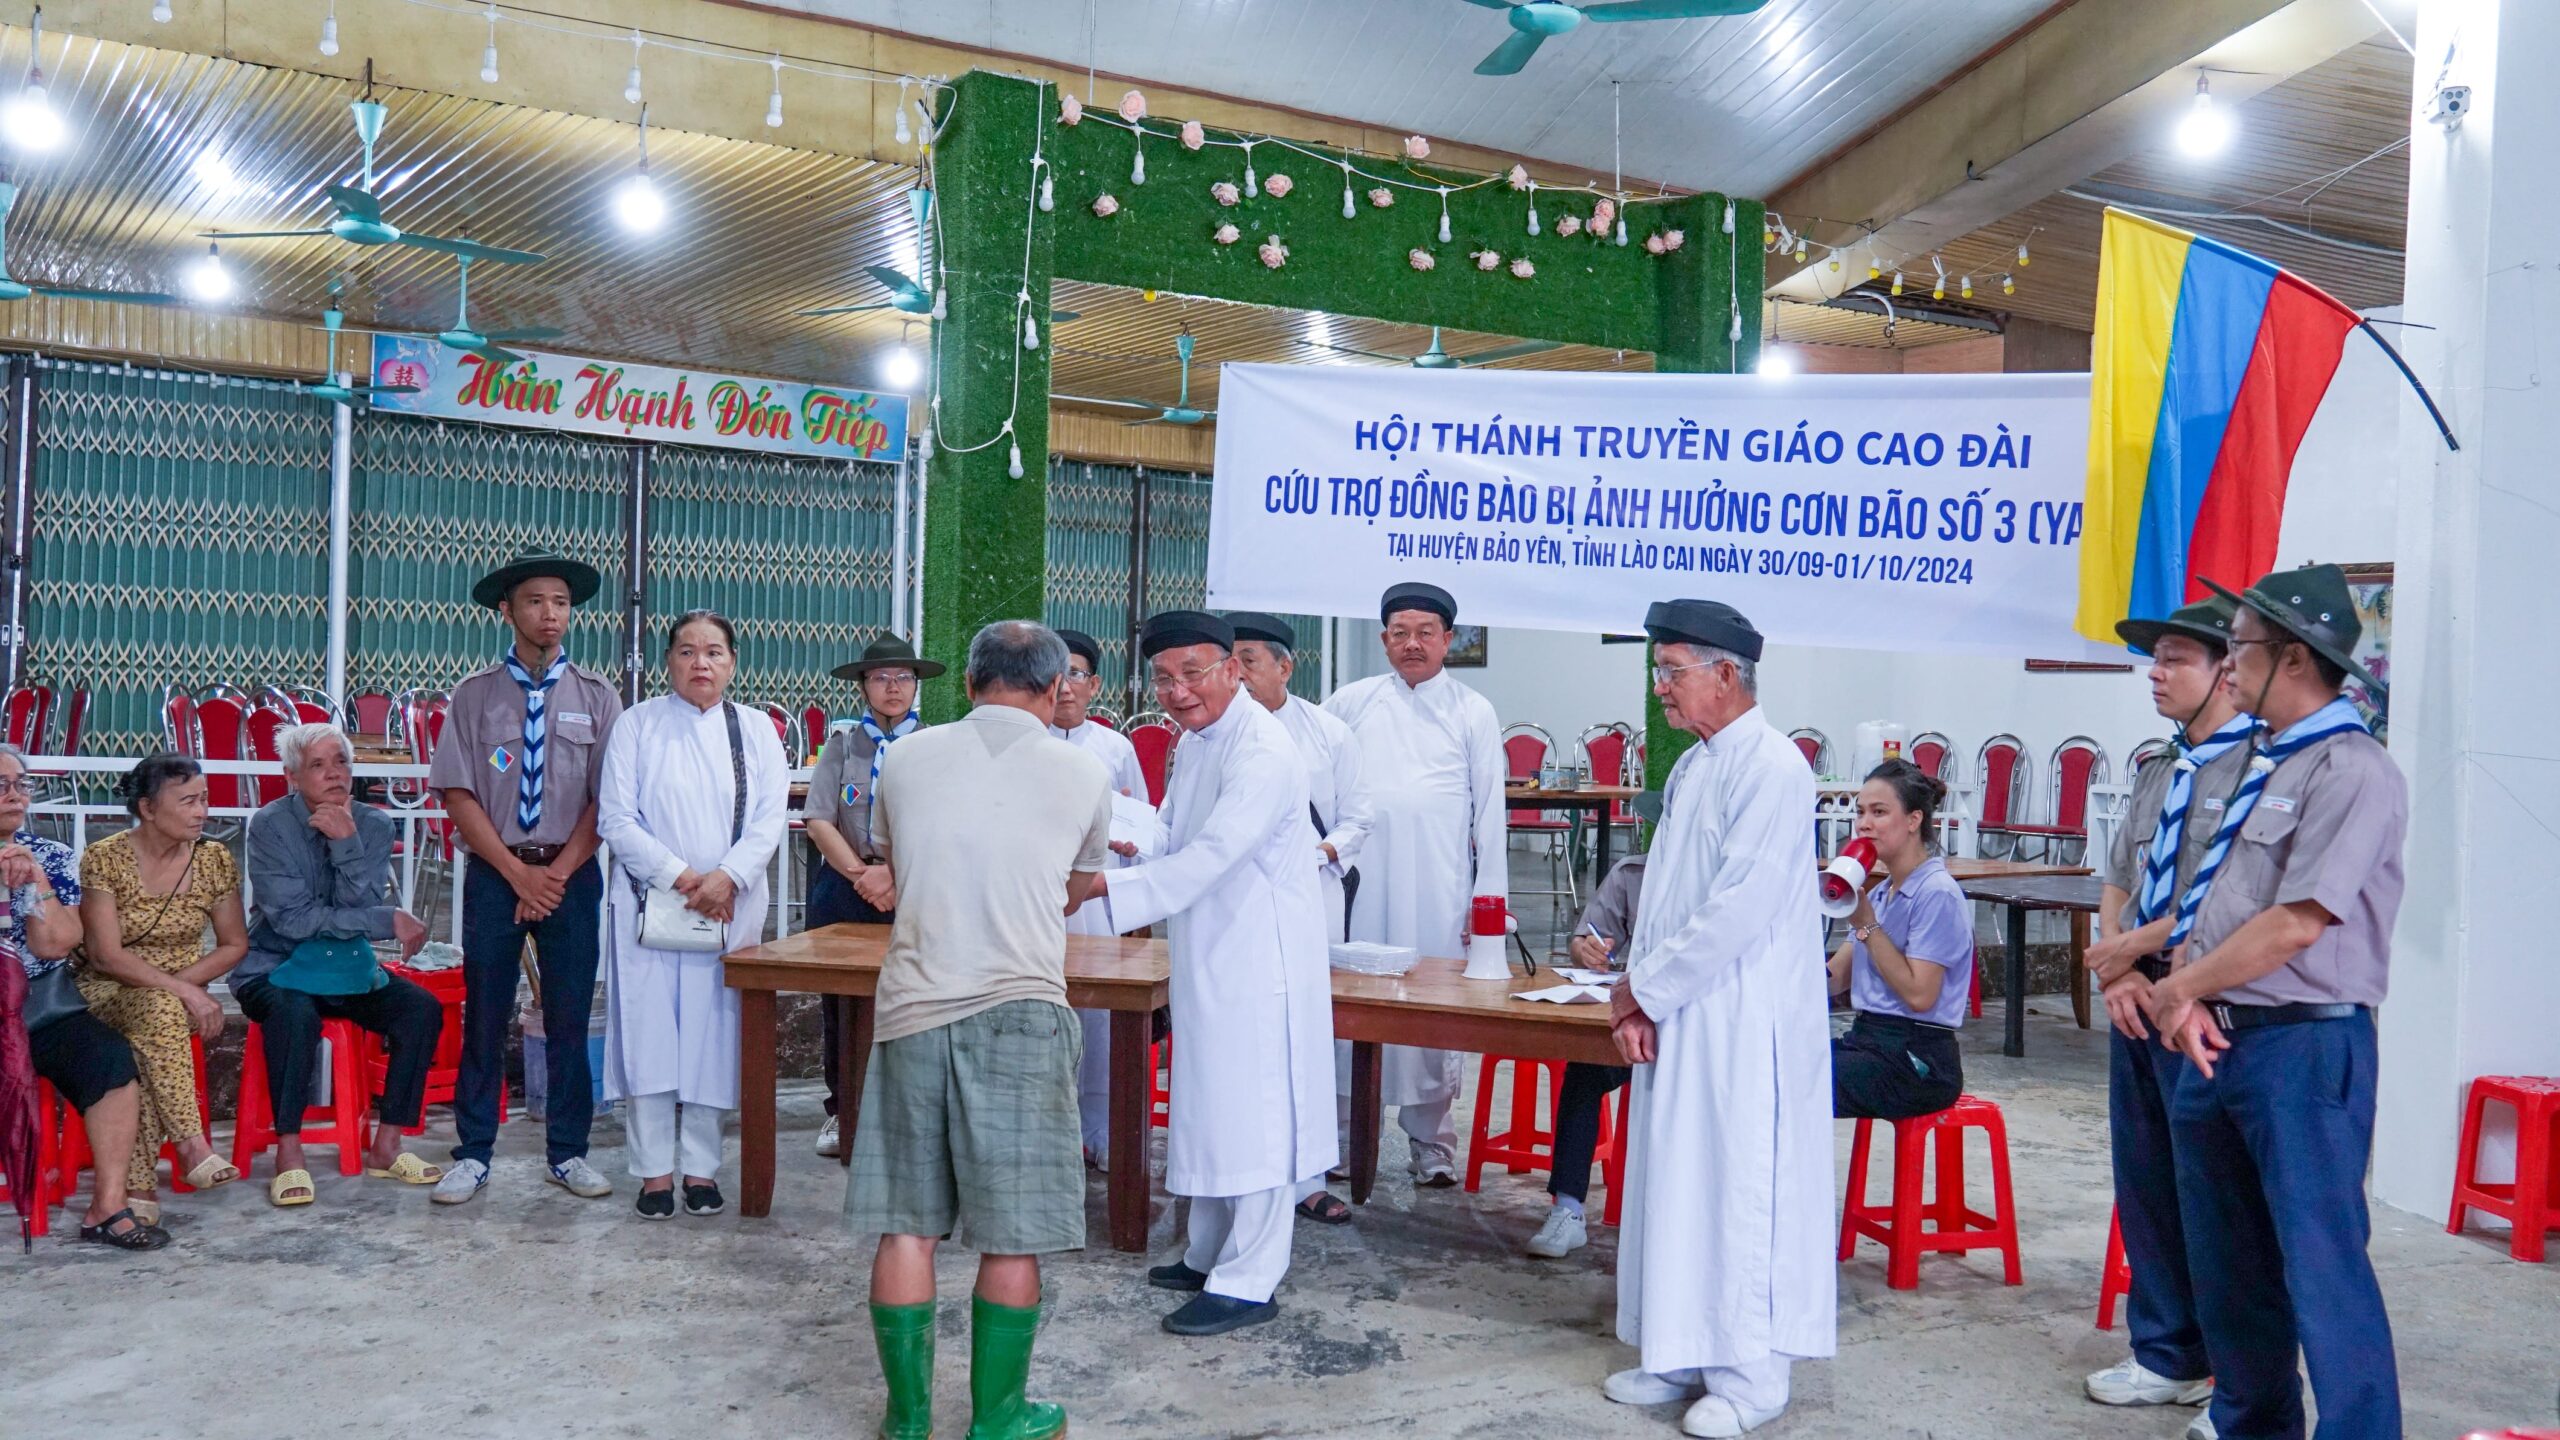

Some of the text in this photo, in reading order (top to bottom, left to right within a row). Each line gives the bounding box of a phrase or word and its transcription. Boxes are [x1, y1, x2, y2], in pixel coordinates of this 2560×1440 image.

[457, 353, 890, 459] Hân Hạnh Đón Tiếp
[1355, 413, 2032, 469] HỘI THÁNH TRUYỀN GIÁO CAO ĐÀI
[1265, 468, 1320, 515] CỨU
[1328, 476, 1384, 526] TRỢ
[1389, 468, 1469, 522] ĐỒNG
[1477, 475, 1538, 525] BÀO
[1546, 485, 1577, 535] BỊ
[1583, 474, 1652, 530] ẢNH
[1660, 478, 1772, 535] HƯỞNG
[1780, 490, 1849, 538] CƠN
[1857, 488, 1929, 541] BÃO
[1937, 487, 1992, 543] SỐ
[1993, 499, 2017, 544] 3
[1387, 530, 1974, 585] TẠI HUYỆN BẢO YÊN, TỈNH LÀO CAI NGÀY 30/09-01/10/2024
